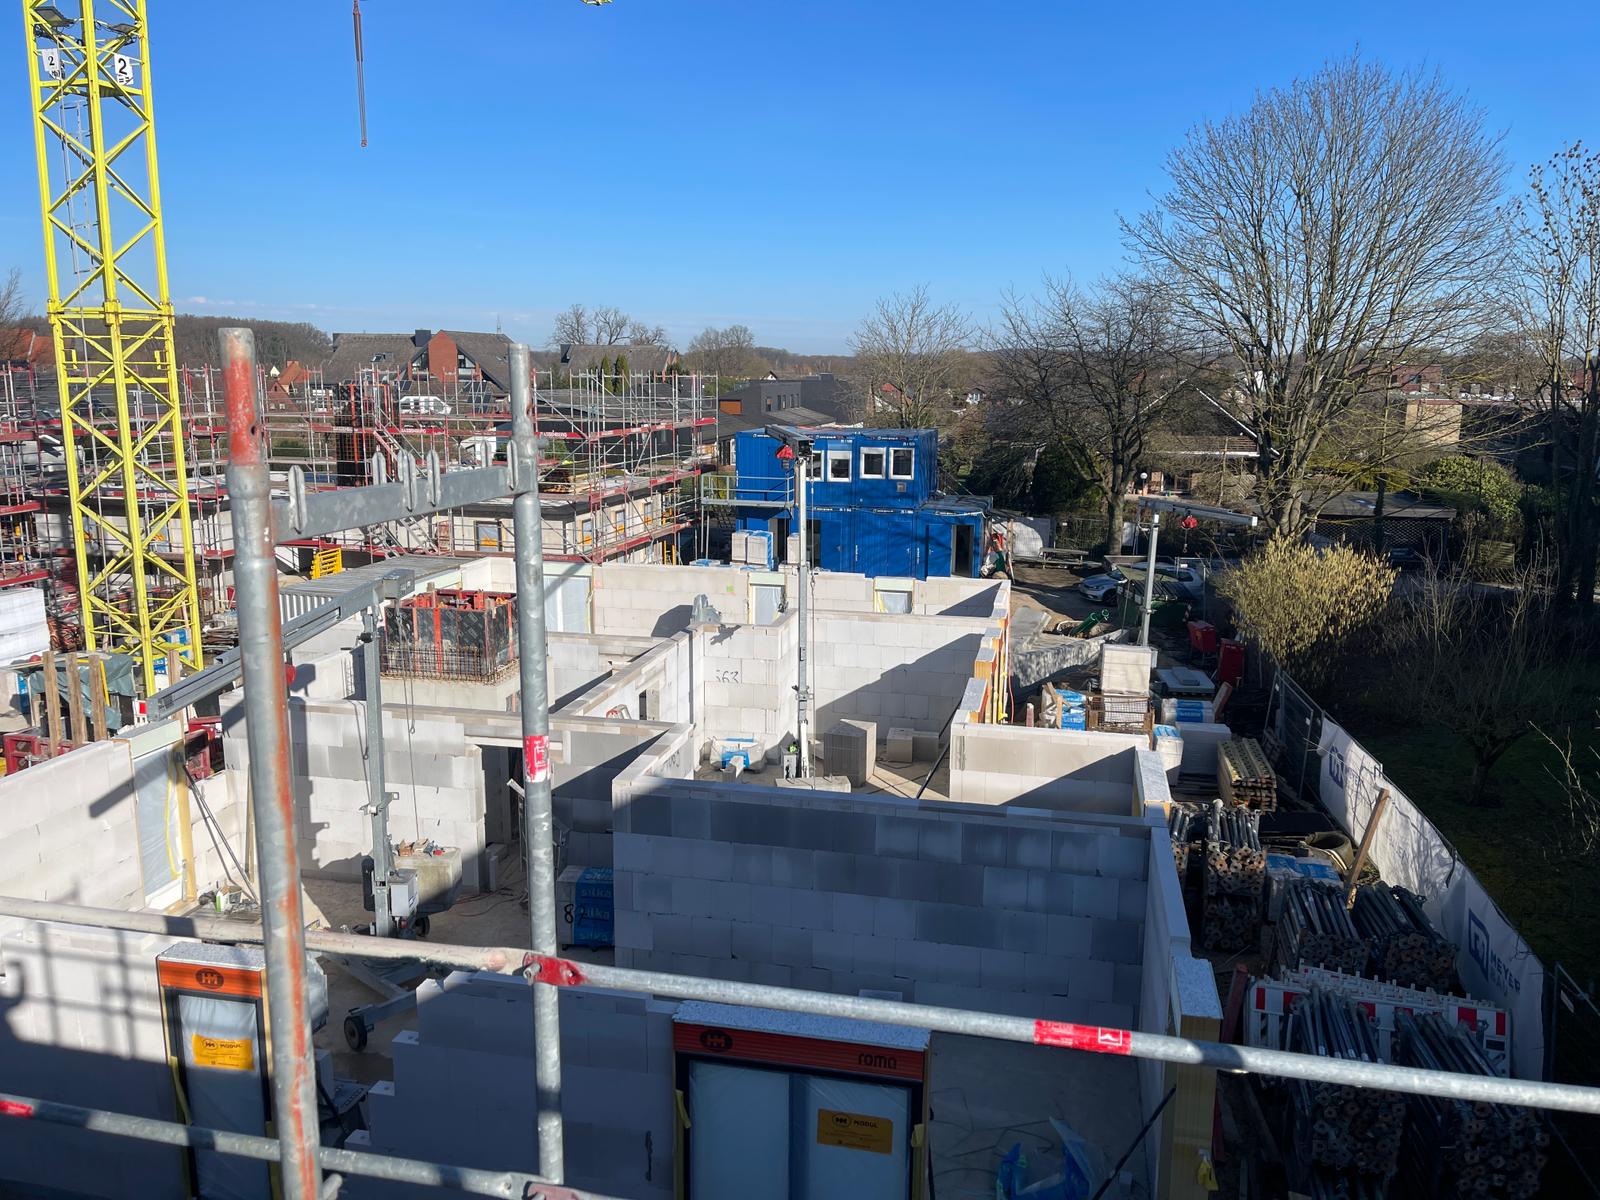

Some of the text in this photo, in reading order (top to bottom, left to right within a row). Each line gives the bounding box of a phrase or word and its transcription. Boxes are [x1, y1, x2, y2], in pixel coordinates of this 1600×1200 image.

[48, 55, 55, 66] 2
[118, 58, 128, 76] 2
[858, 1052, 897, 1070] roma
